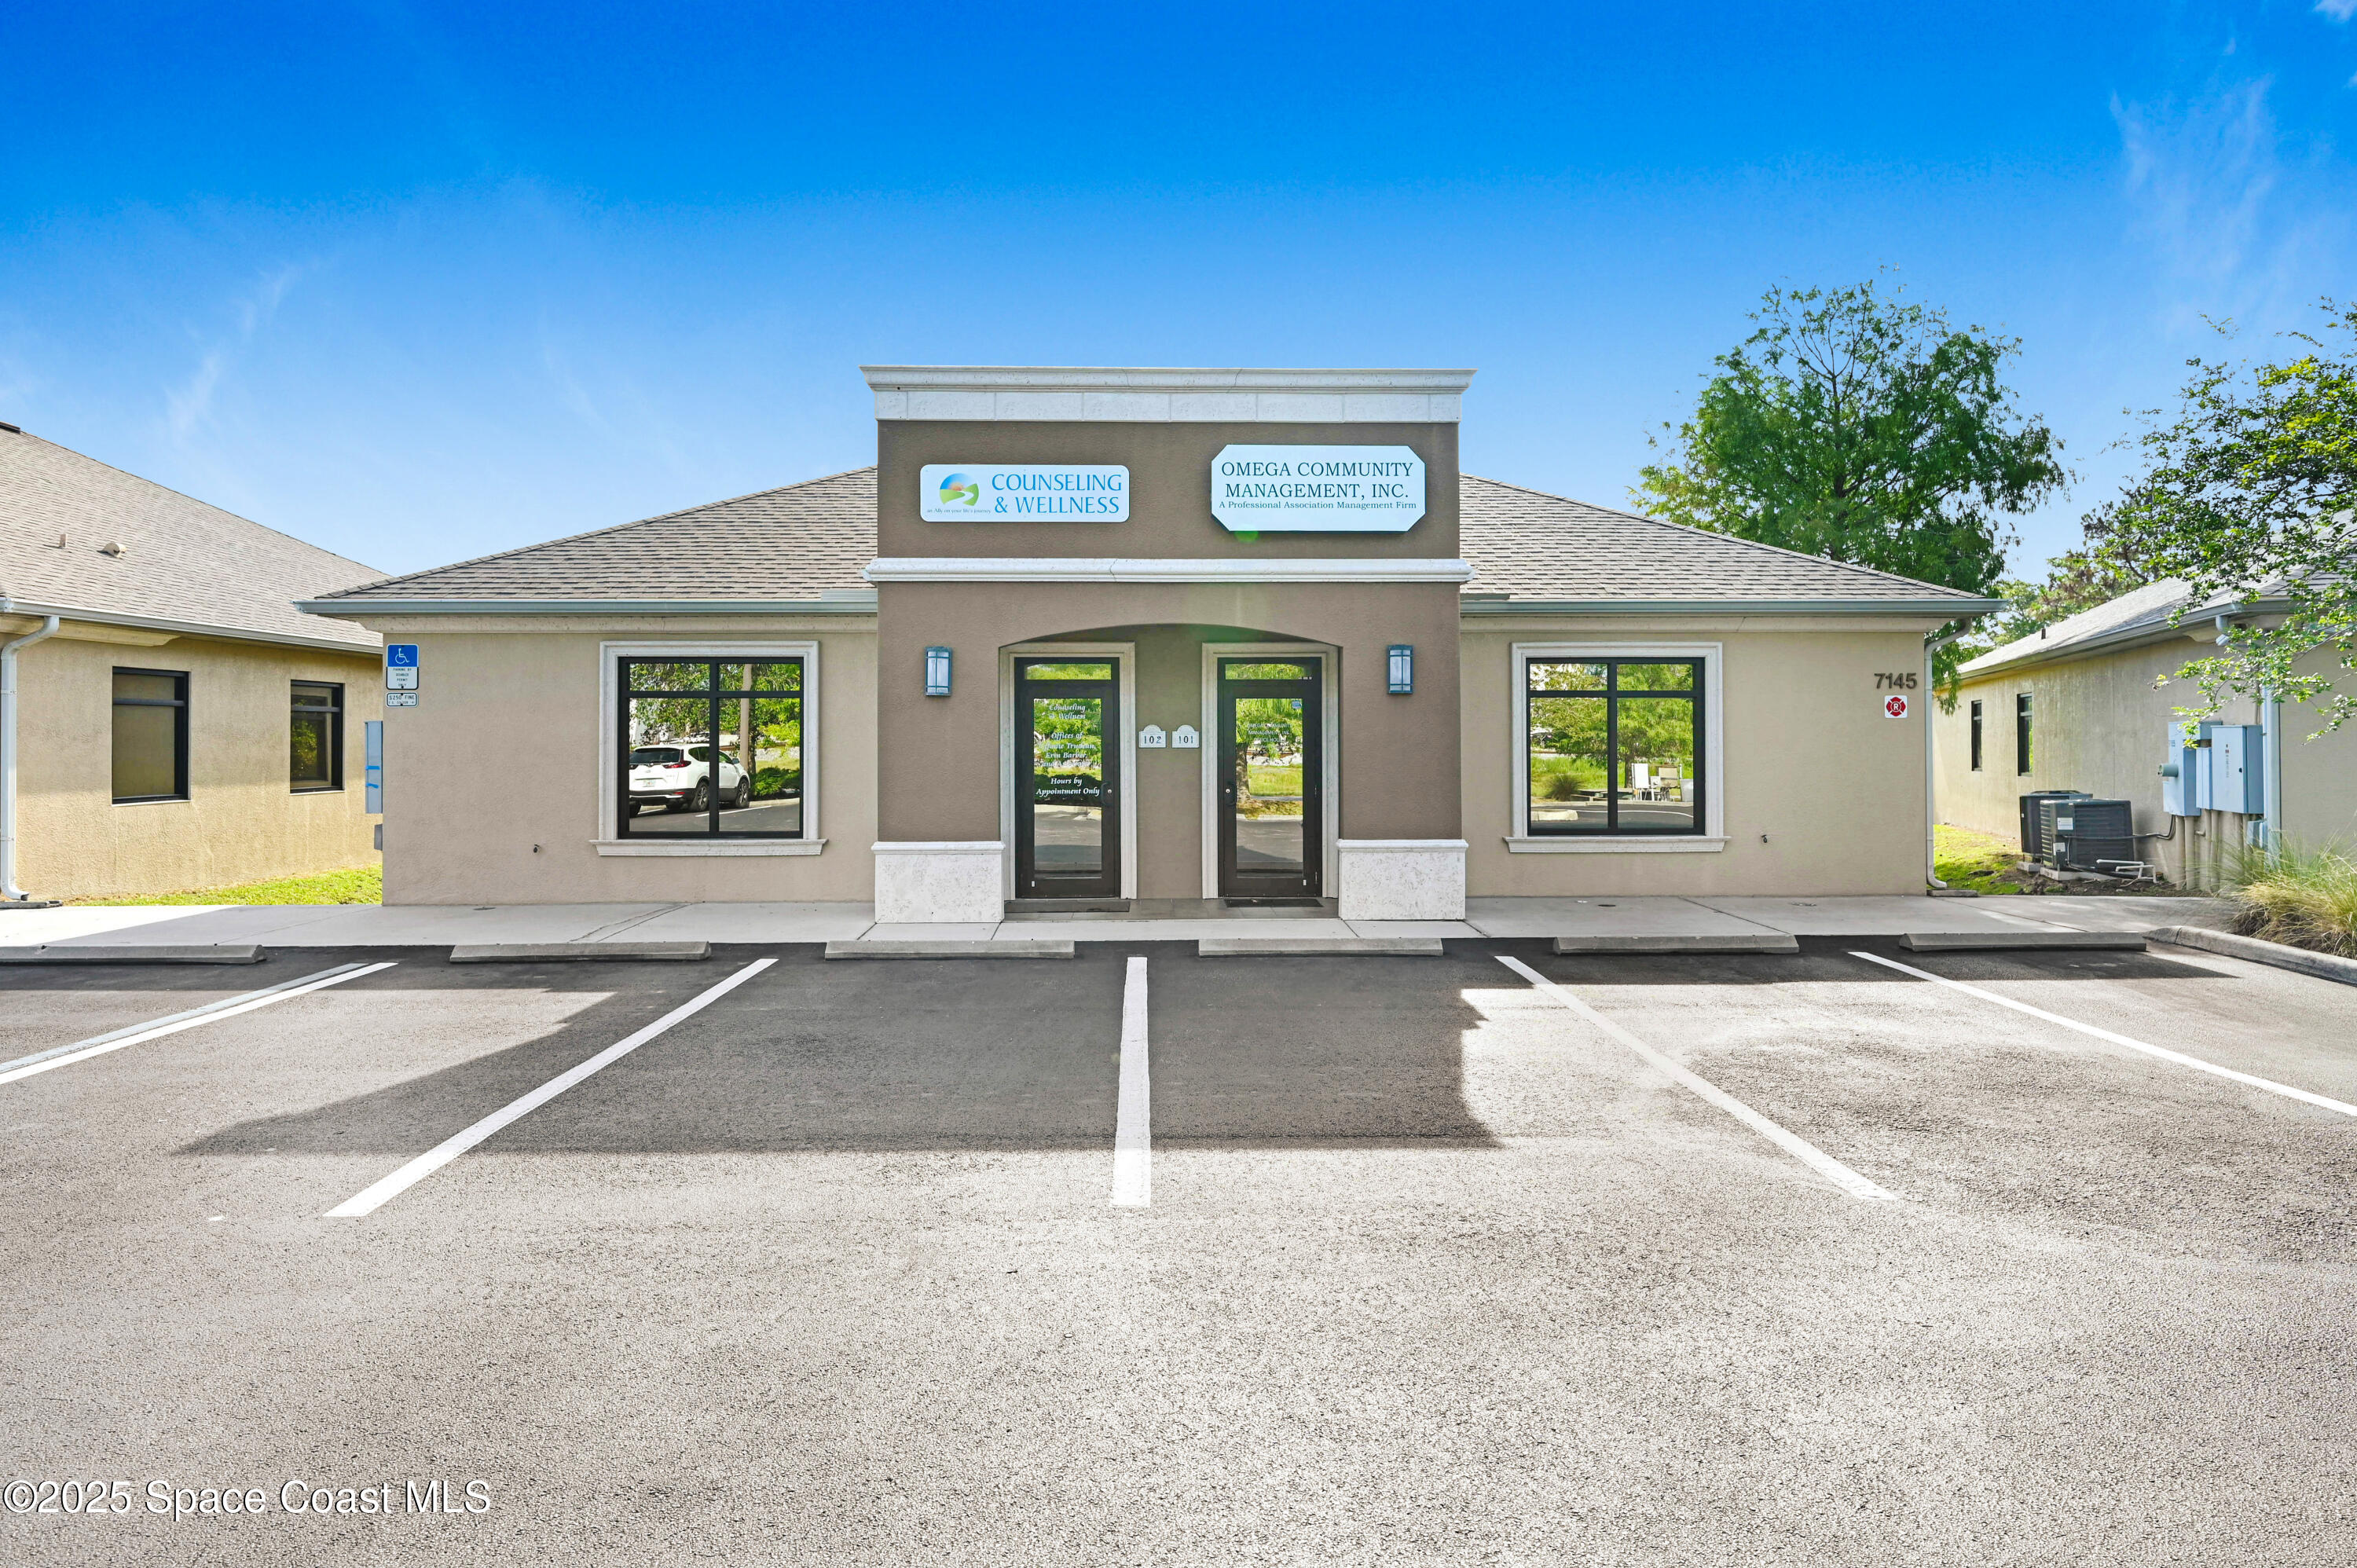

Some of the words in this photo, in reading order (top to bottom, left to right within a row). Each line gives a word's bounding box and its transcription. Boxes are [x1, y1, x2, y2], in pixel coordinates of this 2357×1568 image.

[1221, 462, 1292, 477] OMEGA
[1297, 462, 1413, 477] COMMUNITY
[992, 474, 1122, 491] COUNSELING
[1226, 483, 1365, 500] MANAGEMENT,
[1372, 483, 1409, 498] INC.
[995, 496, 1008, 514] &
[1015, 496, 1120, 514] WELLNESS
[1228, 500, 1281, 509] Professional
[1336, 501, 1393, 511] Management
[1874, 672, 1918, 689] 7145
[1049, 703, 1086, 713] Counseling
[1051, 731, 1073, 741] Offices
[1076, 731, 1083, 741] of
[1144, 735, 1161, 744] 102
[1178, 735, 1193, 744] 101
[1073, 776, 1083, 787] by
[1036, 788, 1081, 797] Appointment
[1083, 786, 1100, 797] Only
